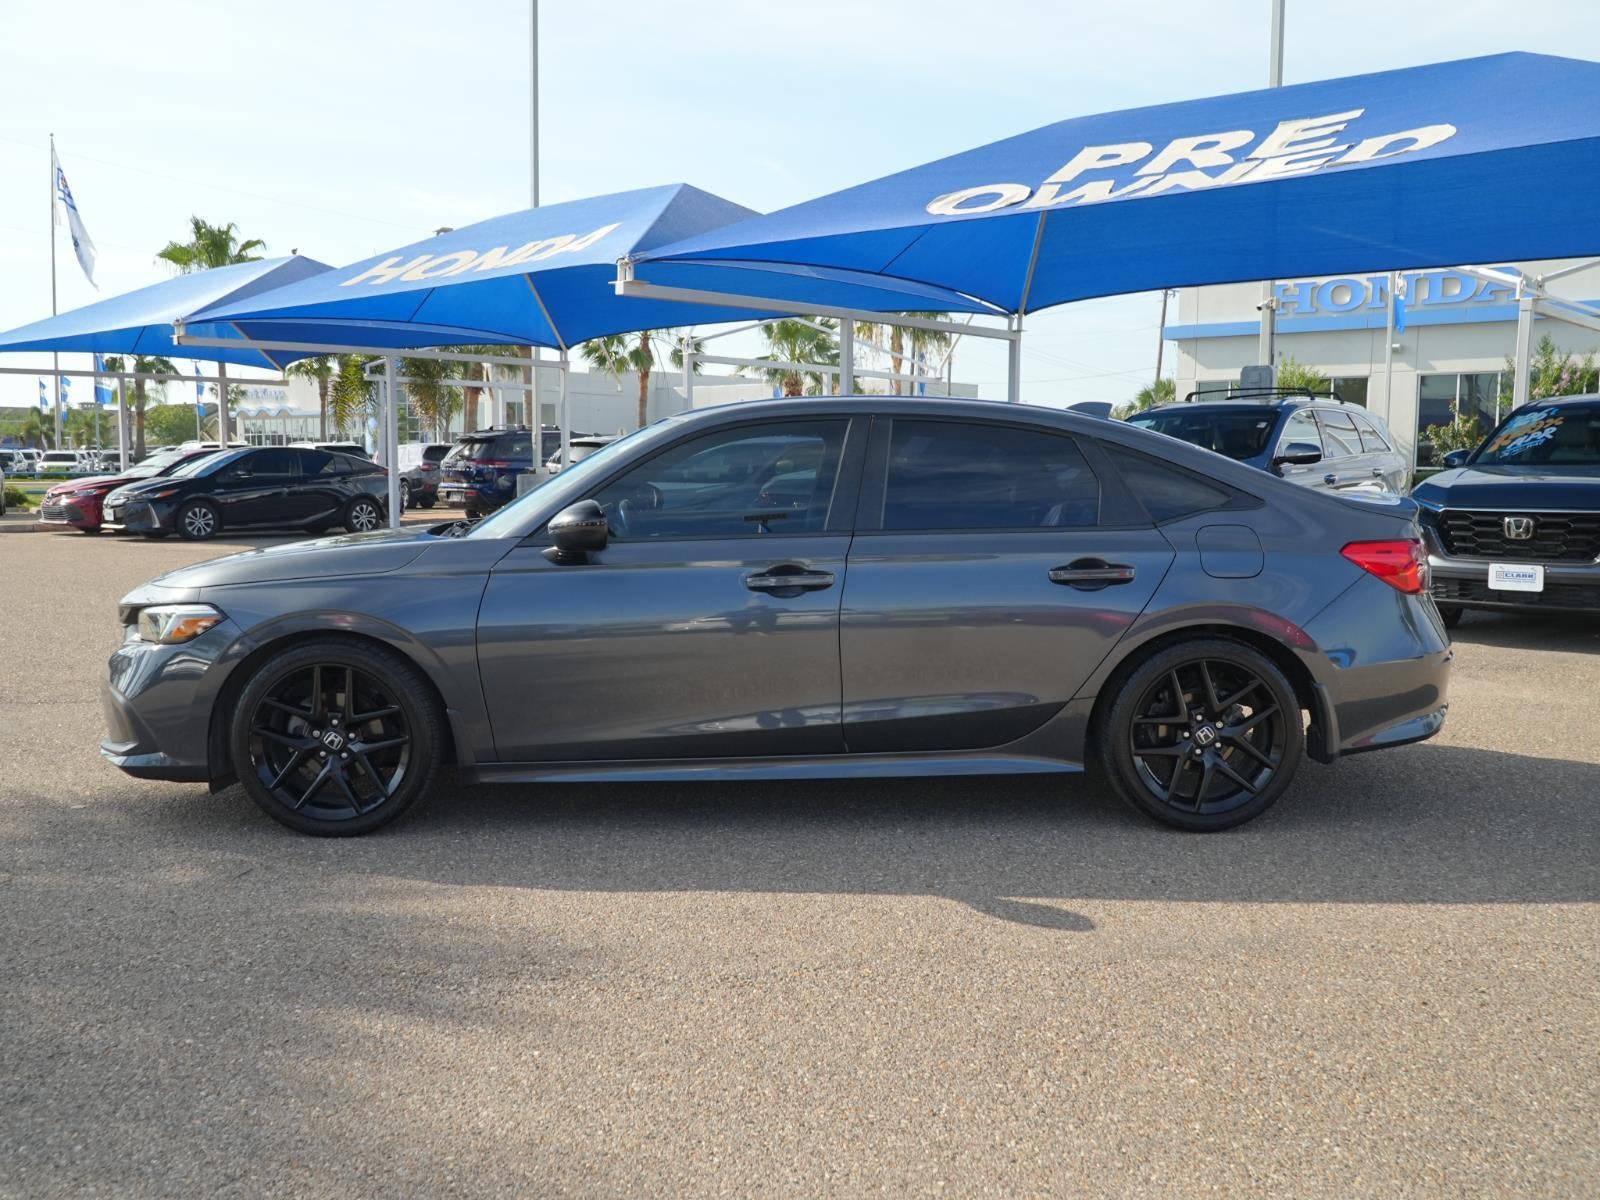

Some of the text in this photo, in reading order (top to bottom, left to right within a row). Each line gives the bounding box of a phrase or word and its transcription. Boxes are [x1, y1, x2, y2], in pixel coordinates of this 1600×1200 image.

[925, 123, 1457, 216] OWNED
[1046, 108, 1365, 184] PRE
[339, 222, 622, 287] HONDA
